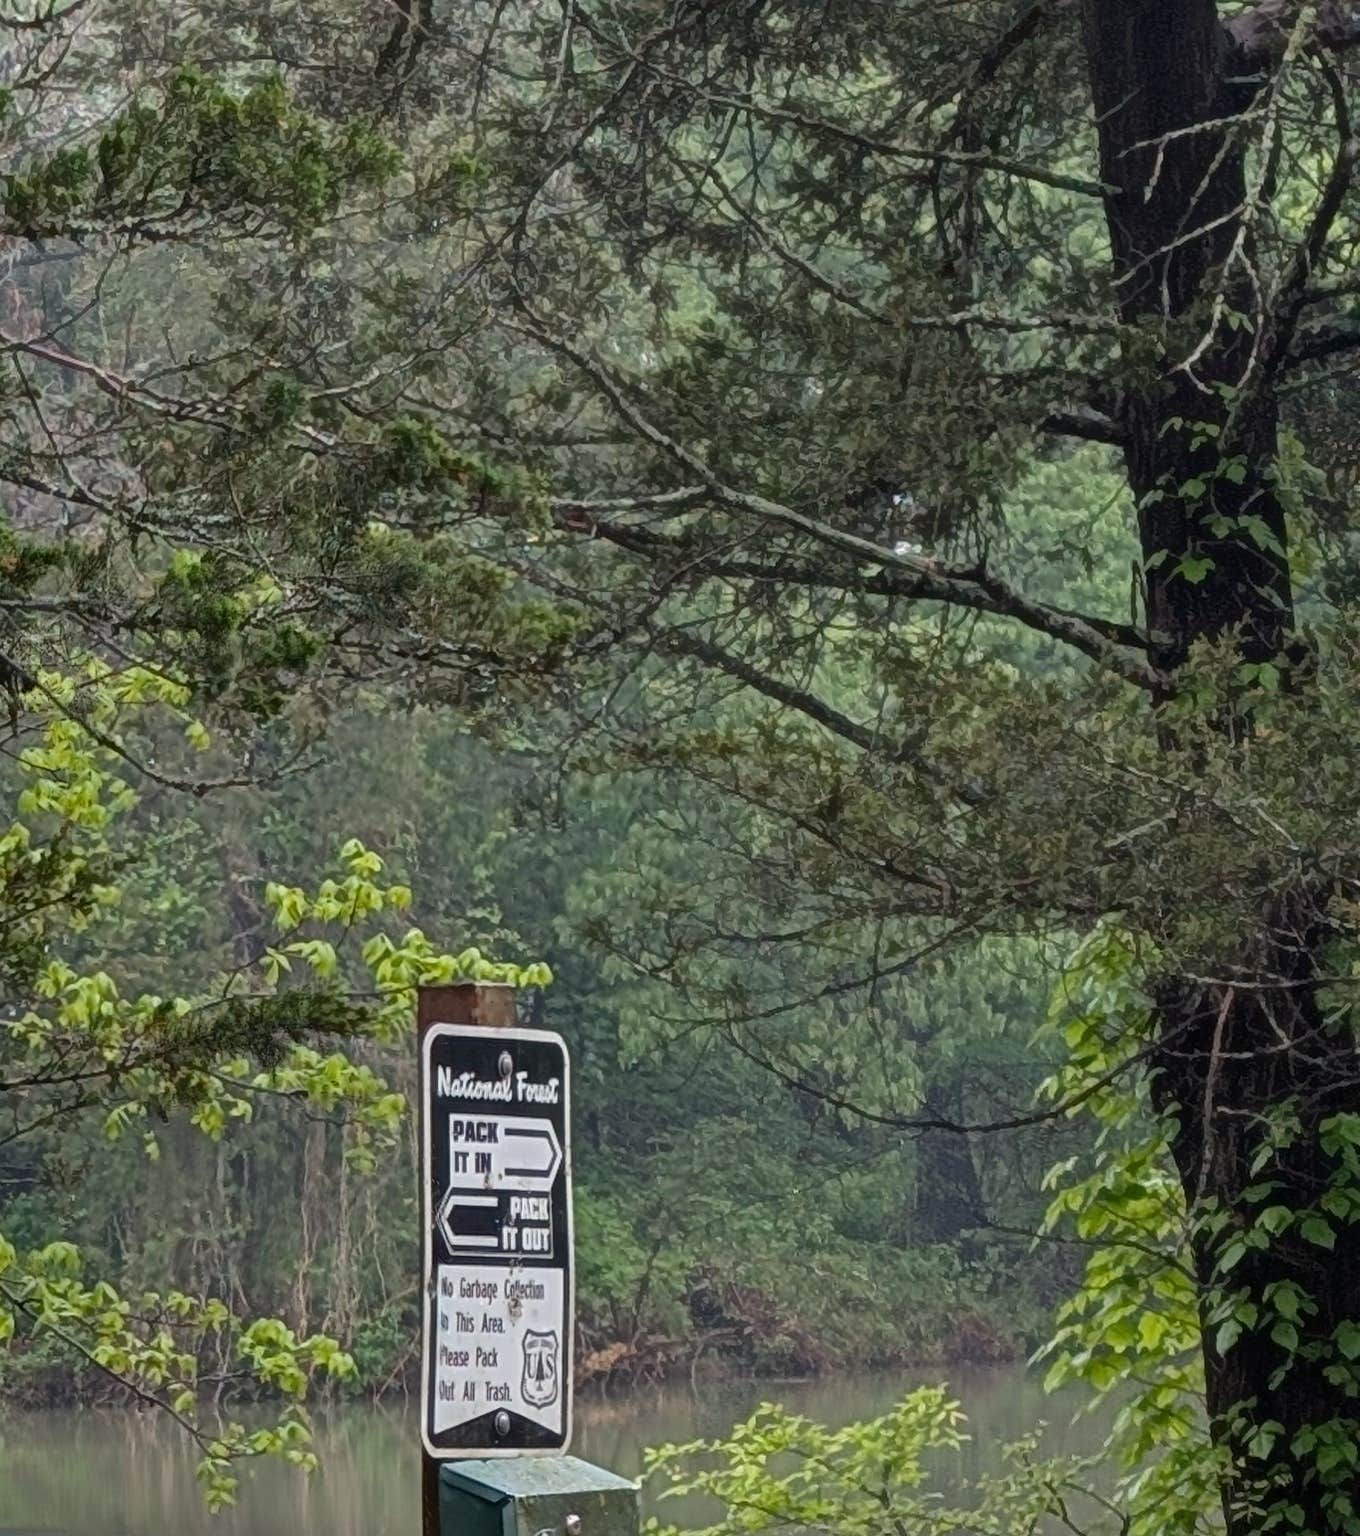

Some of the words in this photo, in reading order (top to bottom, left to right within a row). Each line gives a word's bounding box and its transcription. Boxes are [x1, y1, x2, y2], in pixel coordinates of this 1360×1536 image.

[437, 1065, 512, 1102] National
[516, 1071, 559, 1104] Forest
[453, 1120, 499, 1143] PACK
[454, 1151, 469, 1173] IT
[475, 1152, 492, 1174] IN
[510, 1196, 548, 1220] PACK
[502, 1227, 518, 1250] IT
[522, 1228, 550, 1251] OUT
[441, 1278, 453, 1298] No
[460, 1278, 498, 1305] Garbage
[456, 1312, 475, 1332] This
[481, 1313, 505, 1333] Area.
[439, 1346, 469, 1366] Please
[475, 1347, 498, 1367] Pack
[440, 1382, 455, 1402] Out
[463, 1382, 475, 1402] All
[485, 1382, 512, 1403] Trash.
